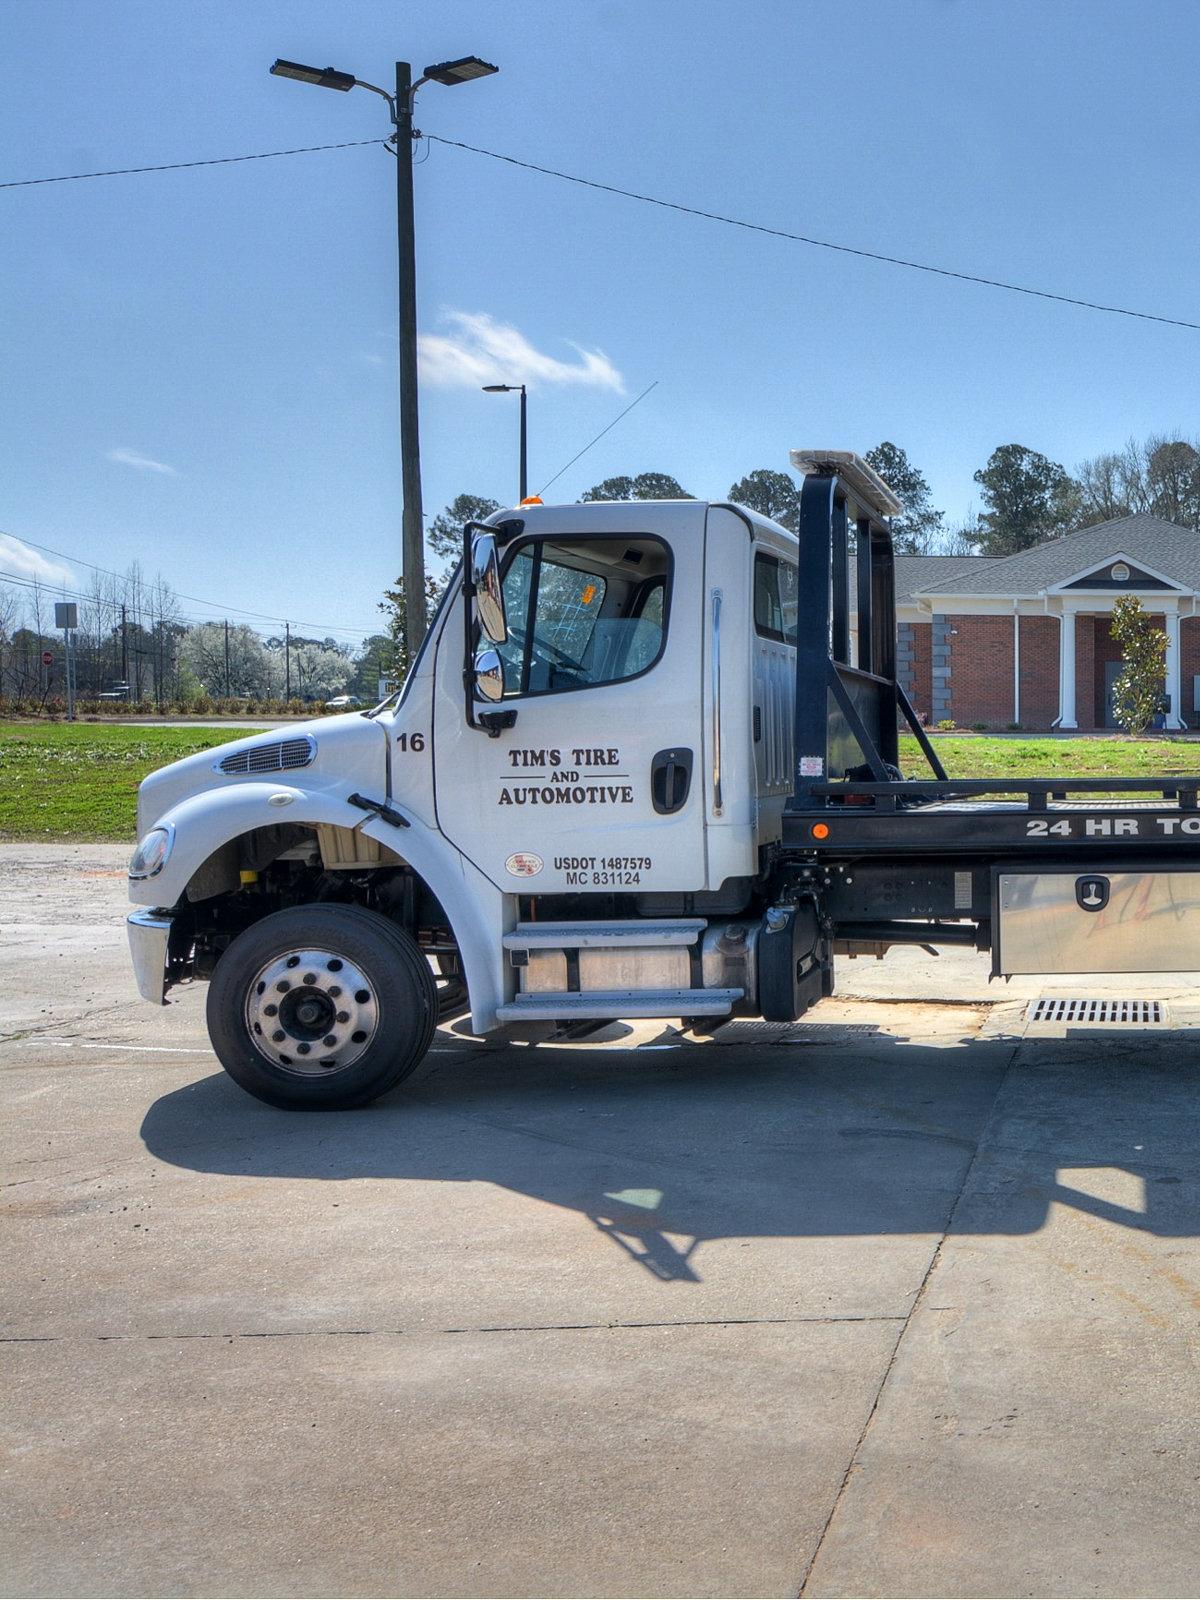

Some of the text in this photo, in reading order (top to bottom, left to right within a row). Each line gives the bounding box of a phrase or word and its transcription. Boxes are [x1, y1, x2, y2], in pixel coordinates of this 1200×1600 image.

[397, 733, 424, 751] 16
[509, 749, 619, 766] TIM'S TIRE
[550, 771, 580, 783] AND
[498, 786, 633, 804] AUTOMOTIVE
[1026, 820, 1072, 836] 24
[1085, 819, 1139, 835] HR
[554, 857, 651, 869] USDOT 1487579
[566, 872, 640, 884] MC 831124
